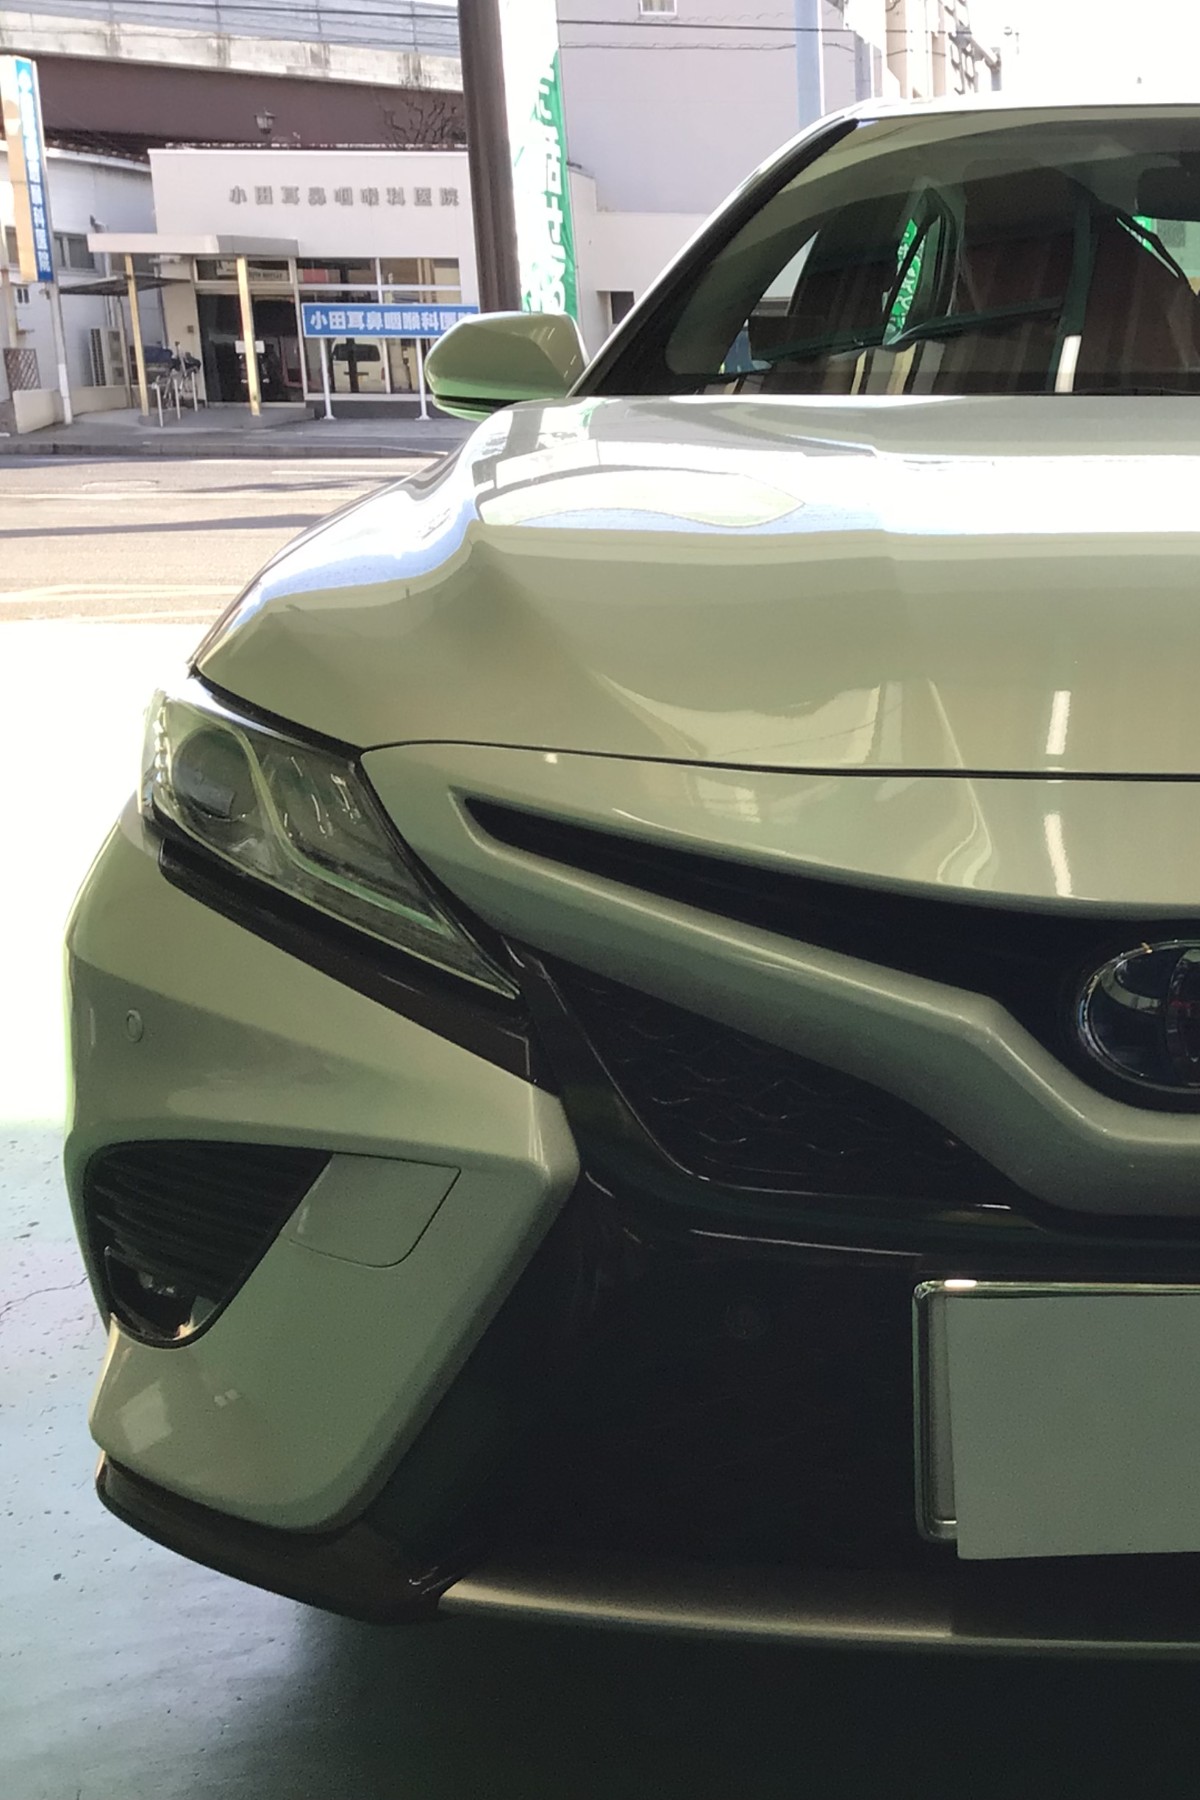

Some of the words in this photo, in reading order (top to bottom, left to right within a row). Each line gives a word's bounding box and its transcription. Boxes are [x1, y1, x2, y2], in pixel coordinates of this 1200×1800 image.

[229, 185, 460, 207] 小田耳鼻咽喉科医院
